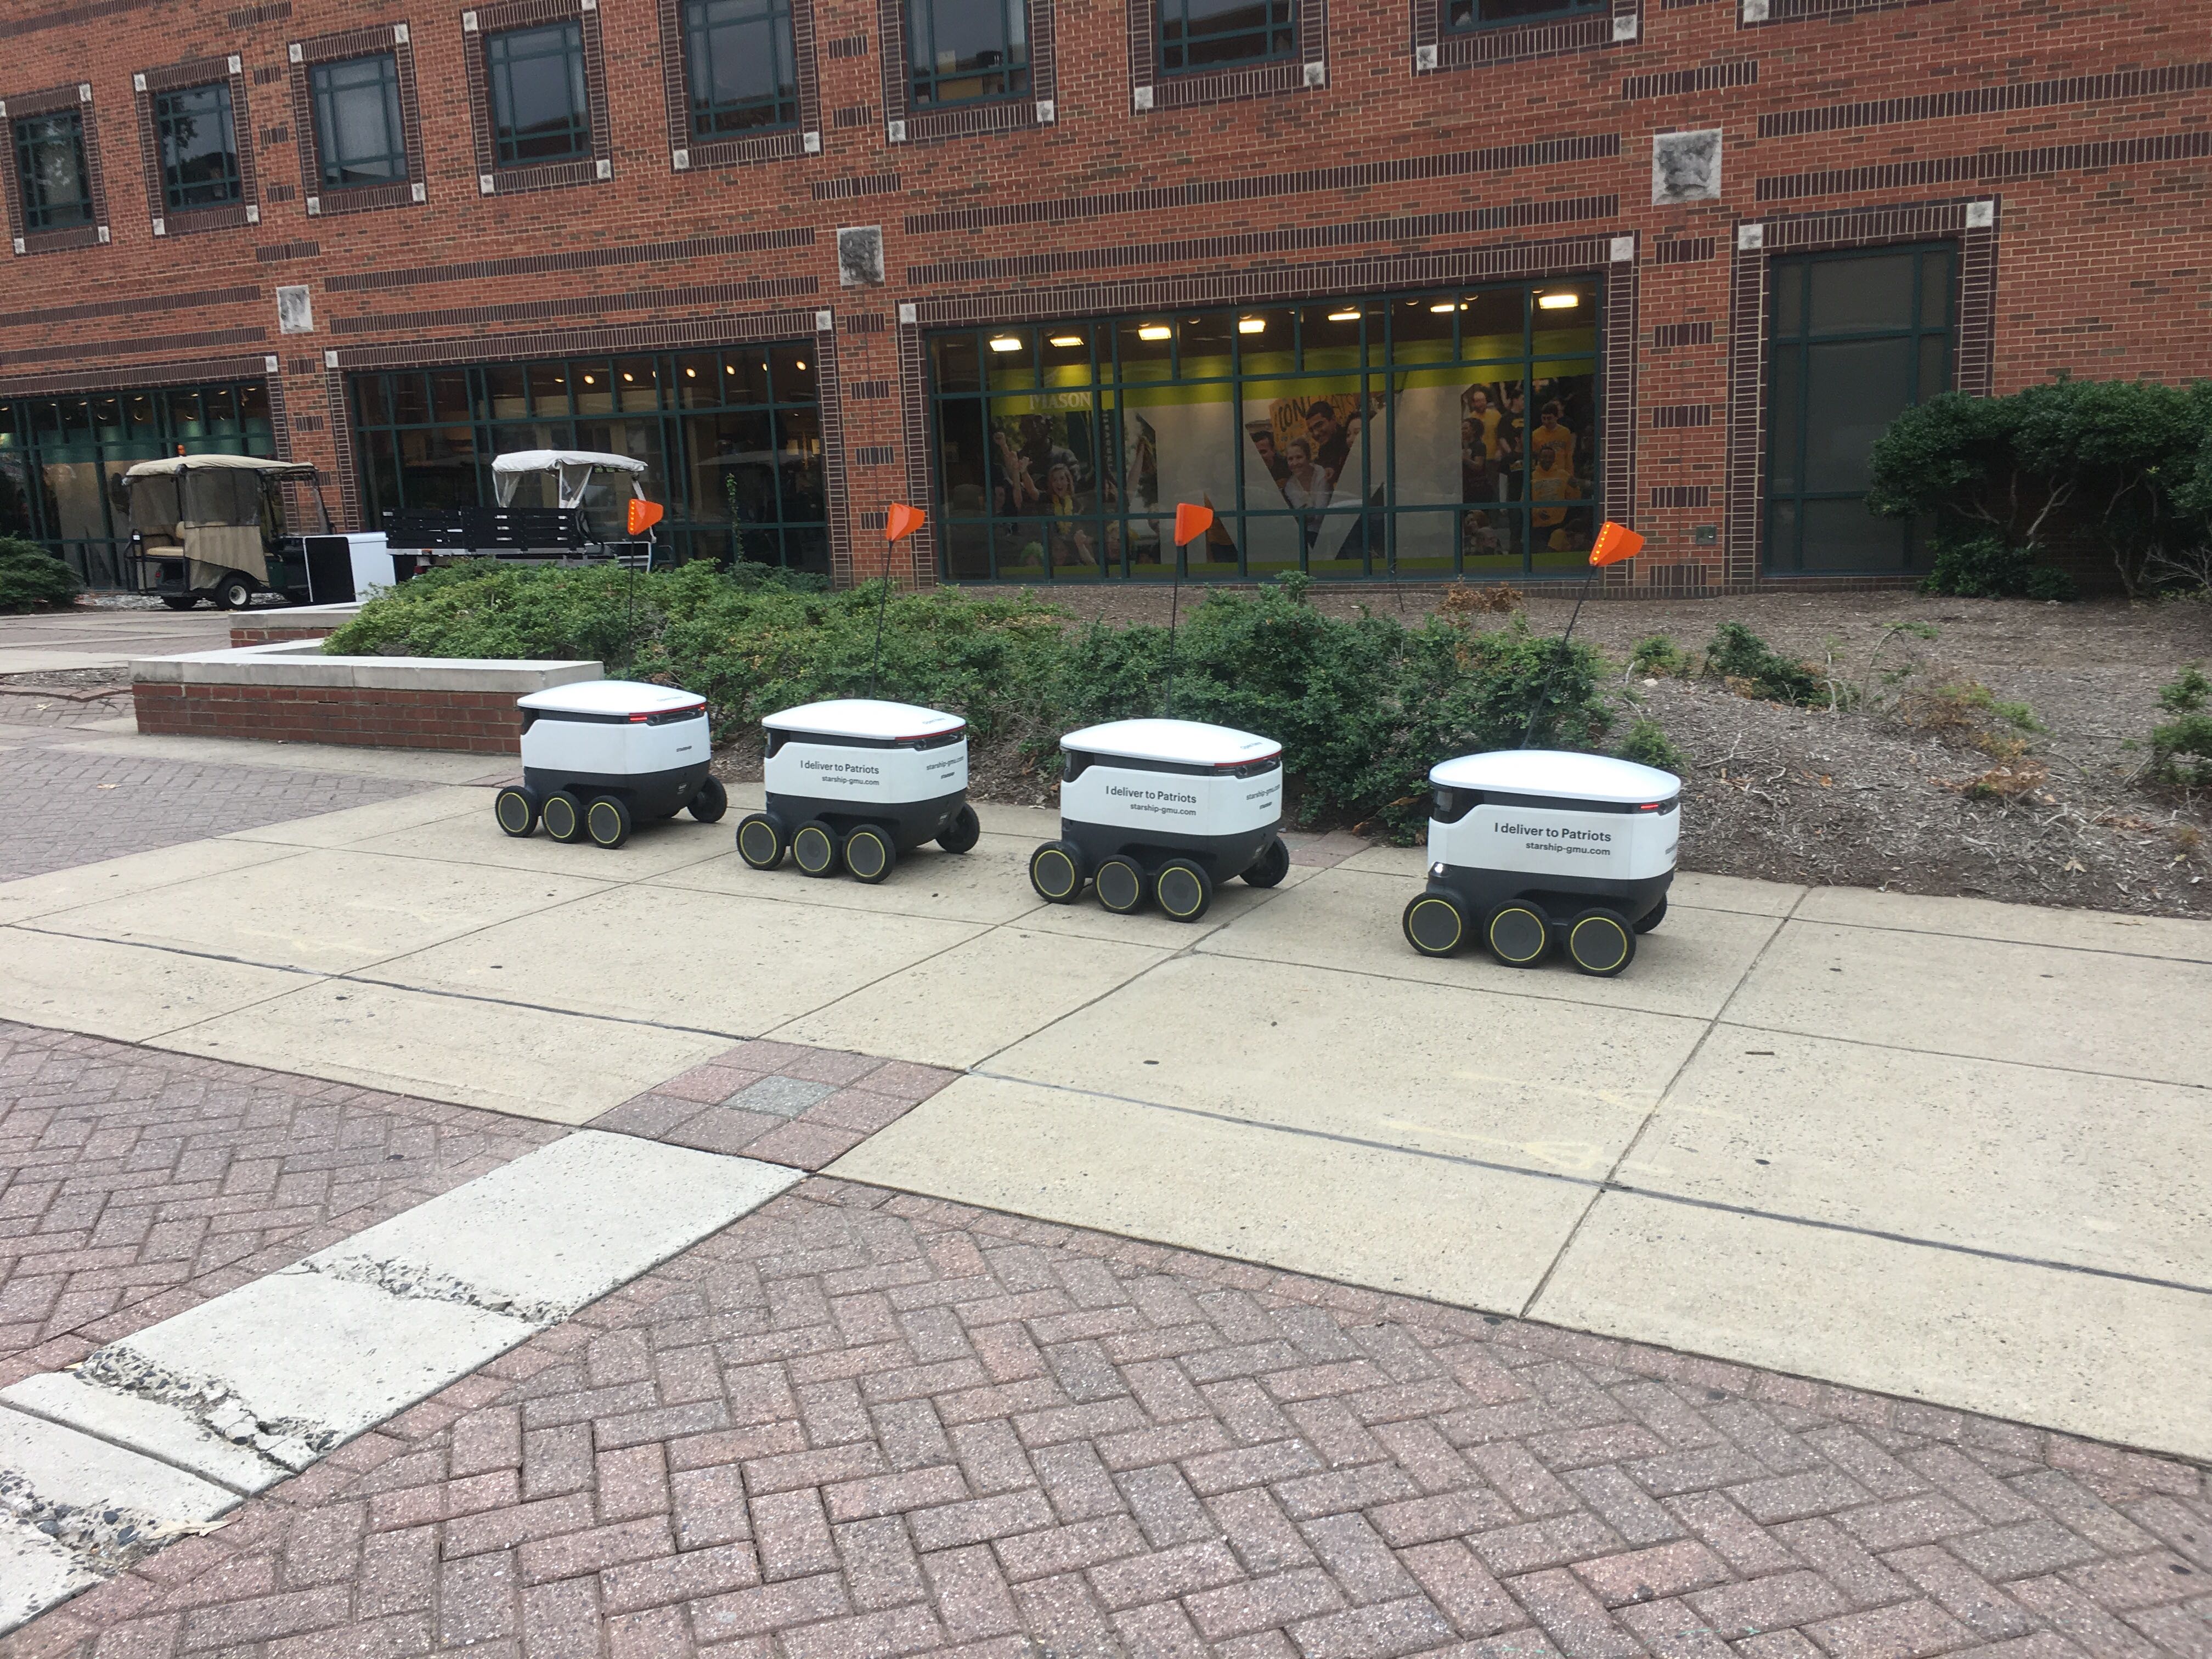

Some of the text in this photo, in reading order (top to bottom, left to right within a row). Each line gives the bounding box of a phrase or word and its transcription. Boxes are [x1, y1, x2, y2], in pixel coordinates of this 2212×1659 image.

[1029, 392, 1092, 410] MASON
[800, 760, 879, 775] I deliver to Patriots
[822, 776, 879, 786] starship-gmu.com
[1106, 786, 1197, 804] I deliver to Patriots
[1130, 804, 1197, 816] starship-gmu.com
[1494, 822, 1611, 842] I deliver to Patriots
[1526, 842, 1611, 856] starship-gmu.com
